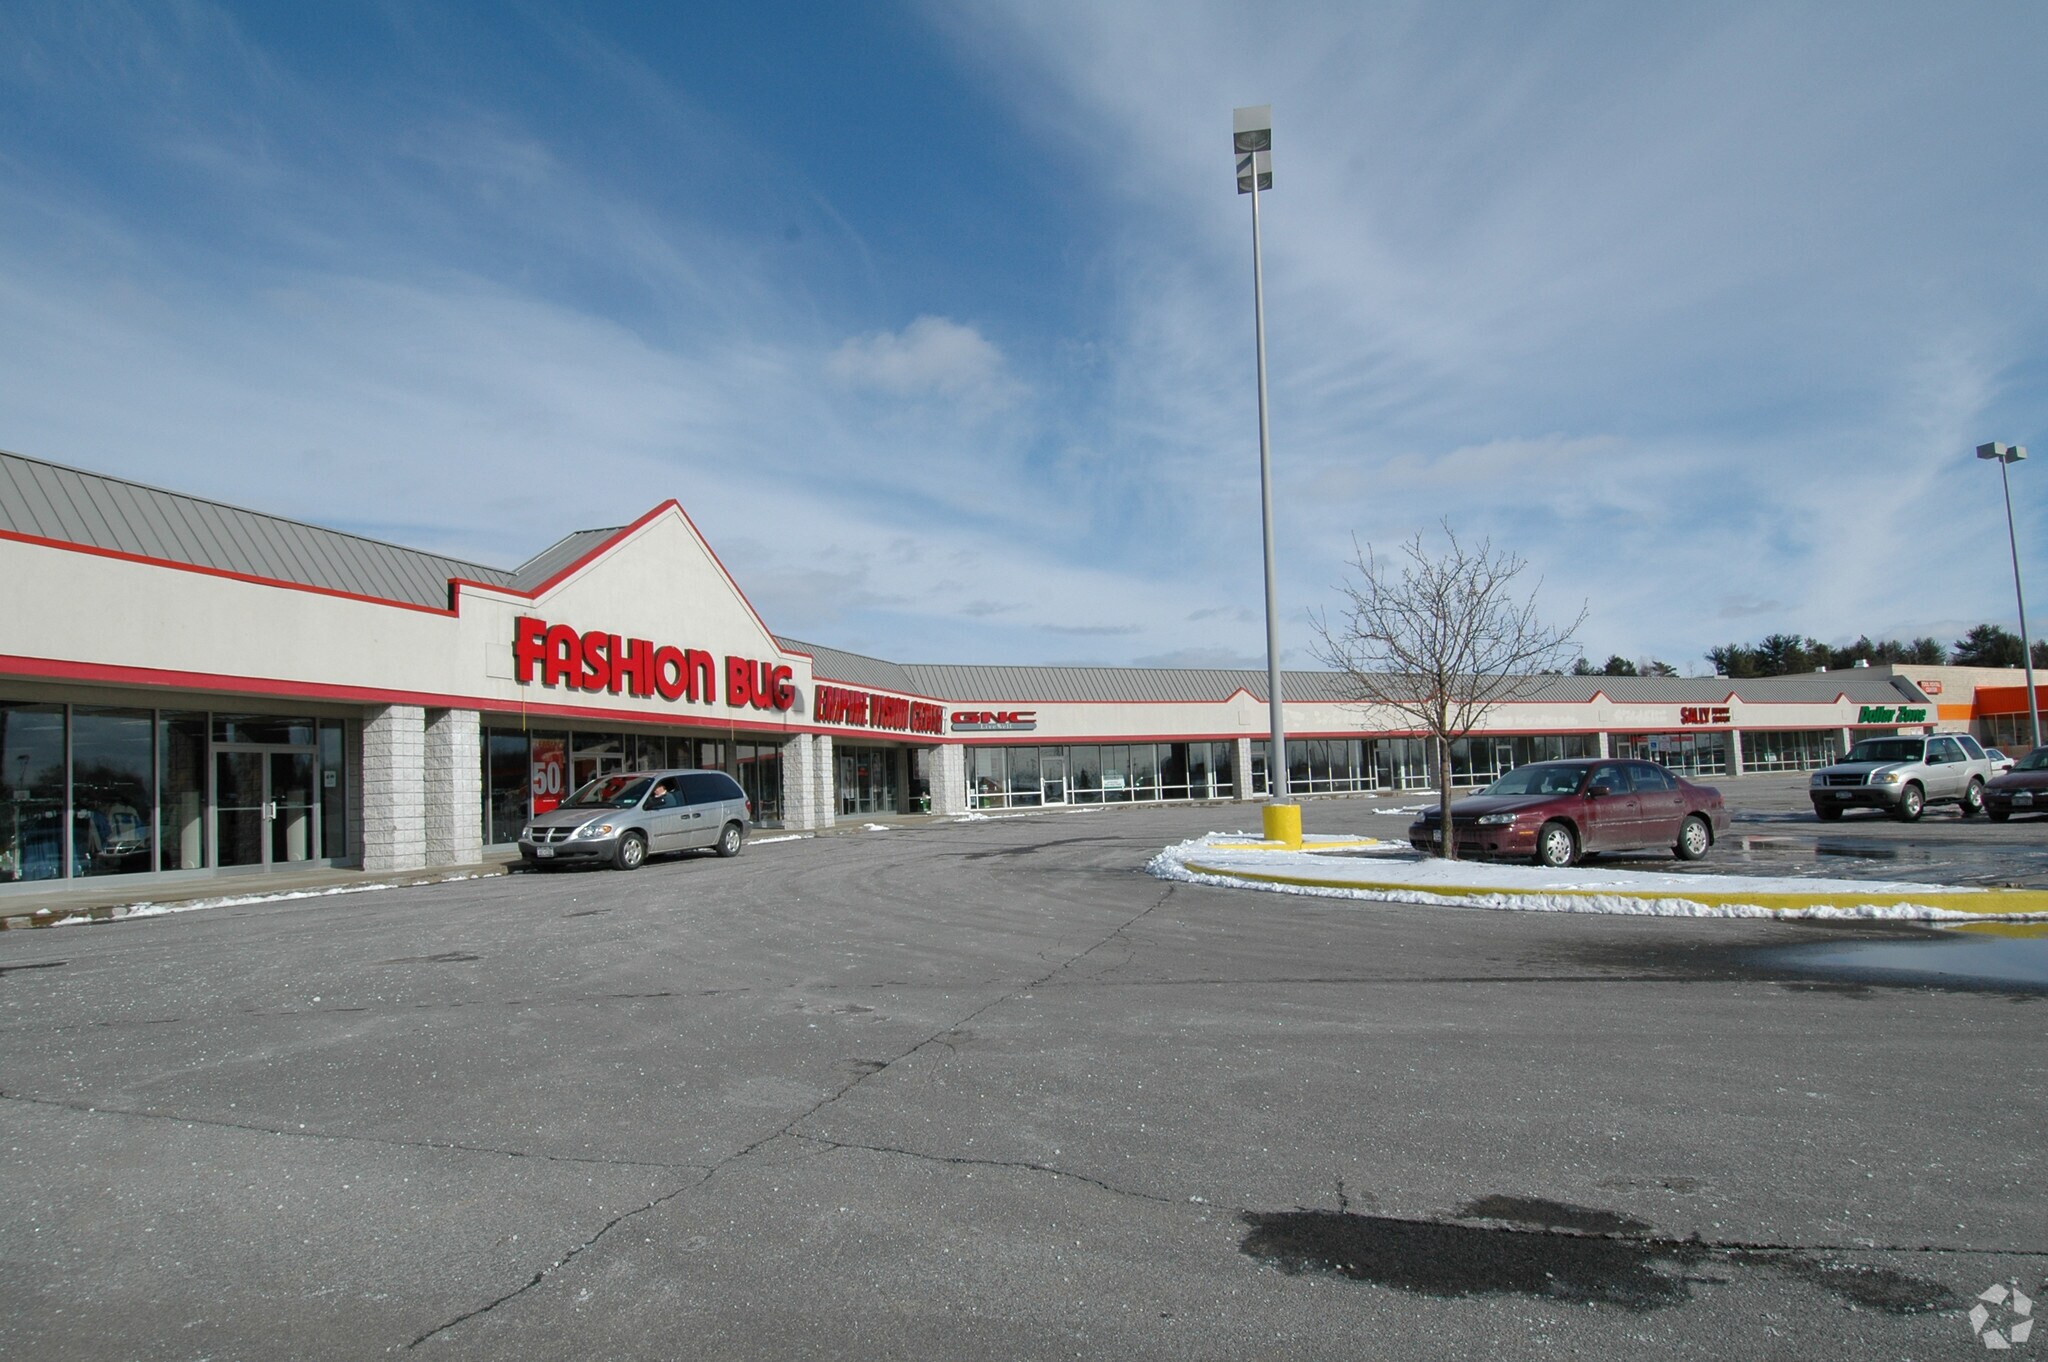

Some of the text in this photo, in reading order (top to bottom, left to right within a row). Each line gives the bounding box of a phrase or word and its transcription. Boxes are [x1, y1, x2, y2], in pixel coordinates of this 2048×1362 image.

[513, 616, 795, 711] FASHION BUG
[814, 684, 869, 726] EMPIRE
[869, 693, 910, 731] VISION
[950, 711, 1037, 724] GNC
[1680, 706, 1711, 725] SALLY
[1858, 705, 1926, 723] Dollar Zone
[533, 761, 561, 795] 50
